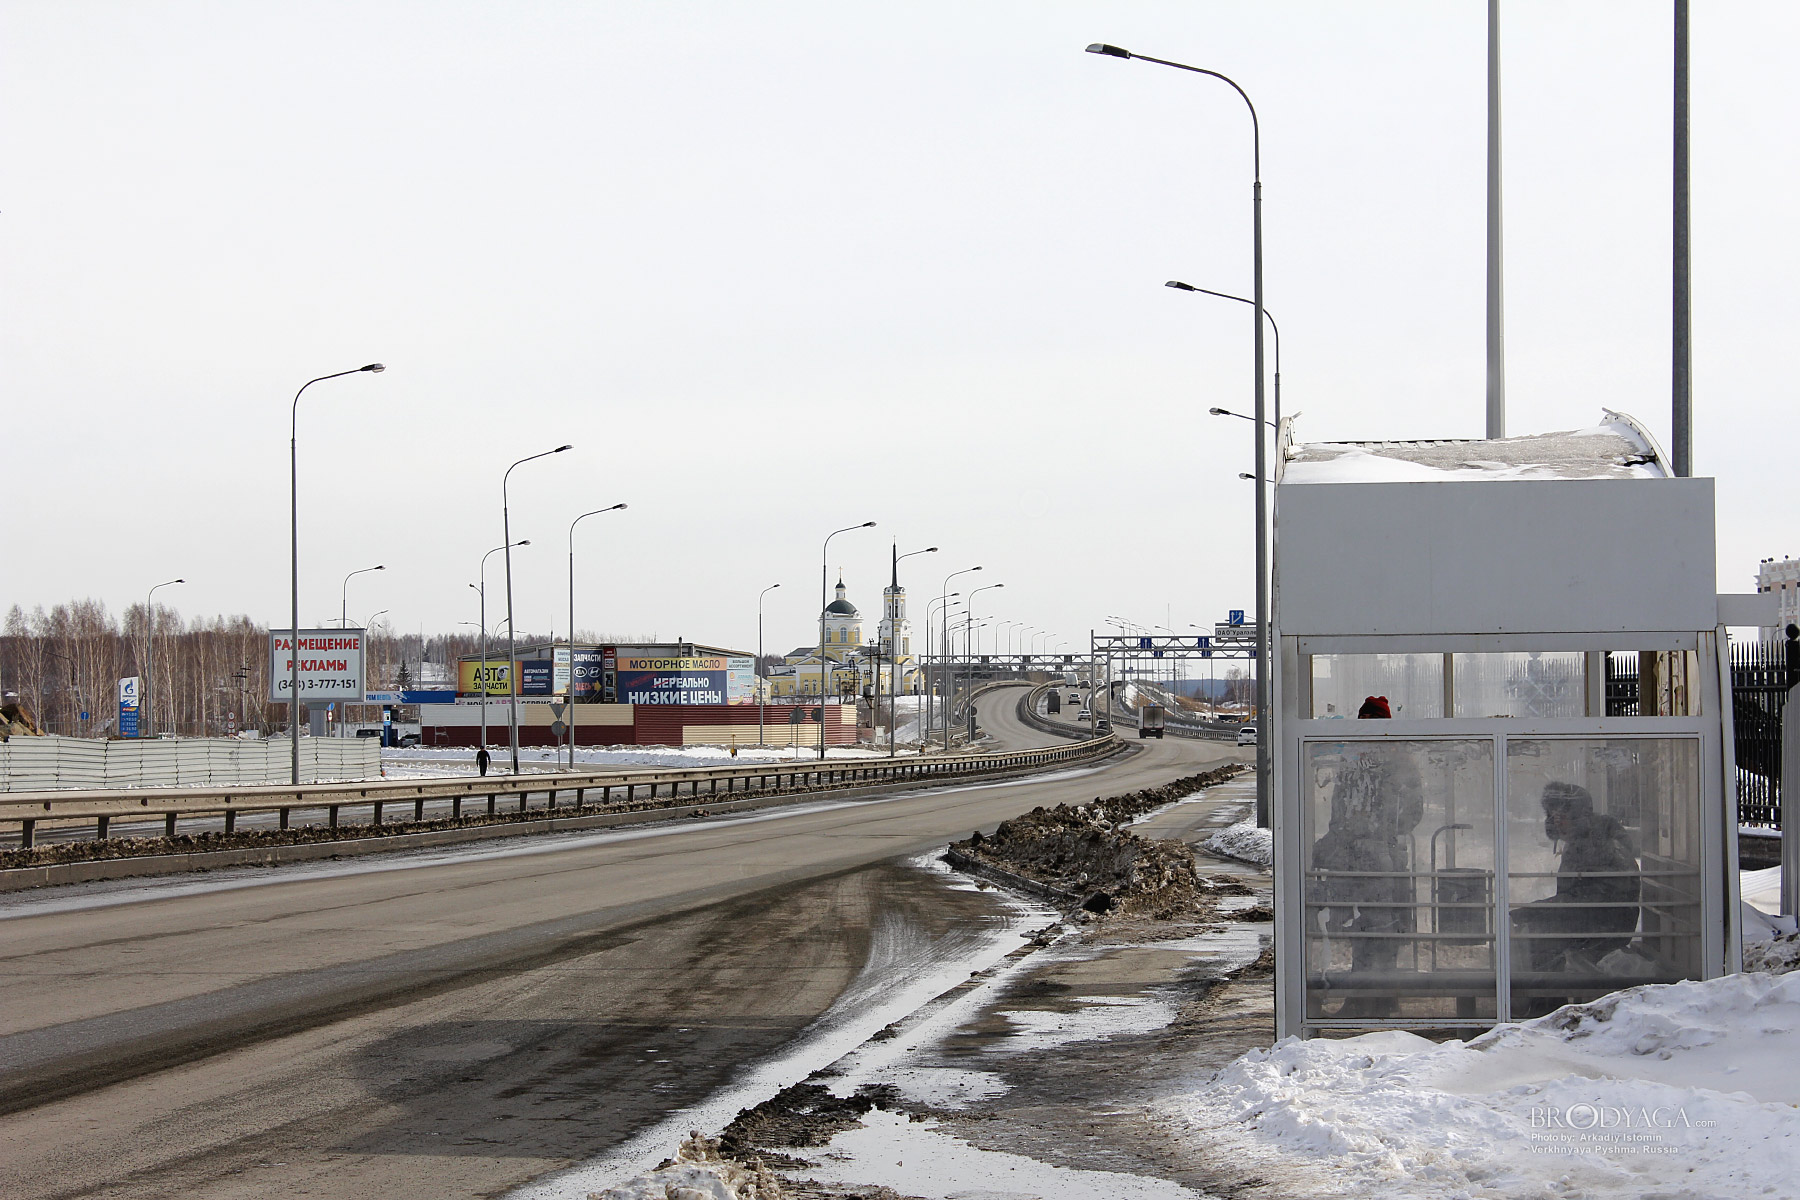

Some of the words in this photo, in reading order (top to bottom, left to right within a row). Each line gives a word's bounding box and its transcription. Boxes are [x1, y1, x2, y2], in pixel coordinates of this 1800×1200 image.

[274, 638, 359, 651] РАМЕЩЕНИЕ
[573, 653, 601, 662] ЗАПЧАСТИ
[629, 659, 690, 669] МОТОРНОЕ
[692, 659, 720, 669] МАСЛО
[307, 679, 356, 689] 3-777-151
[653, 677, 710, 689] НЕРЕАЛЬНО
[628, 691, 689, 704] НИЗКИЕ
[690, 690, 722, 705] ЦЕНЫ
